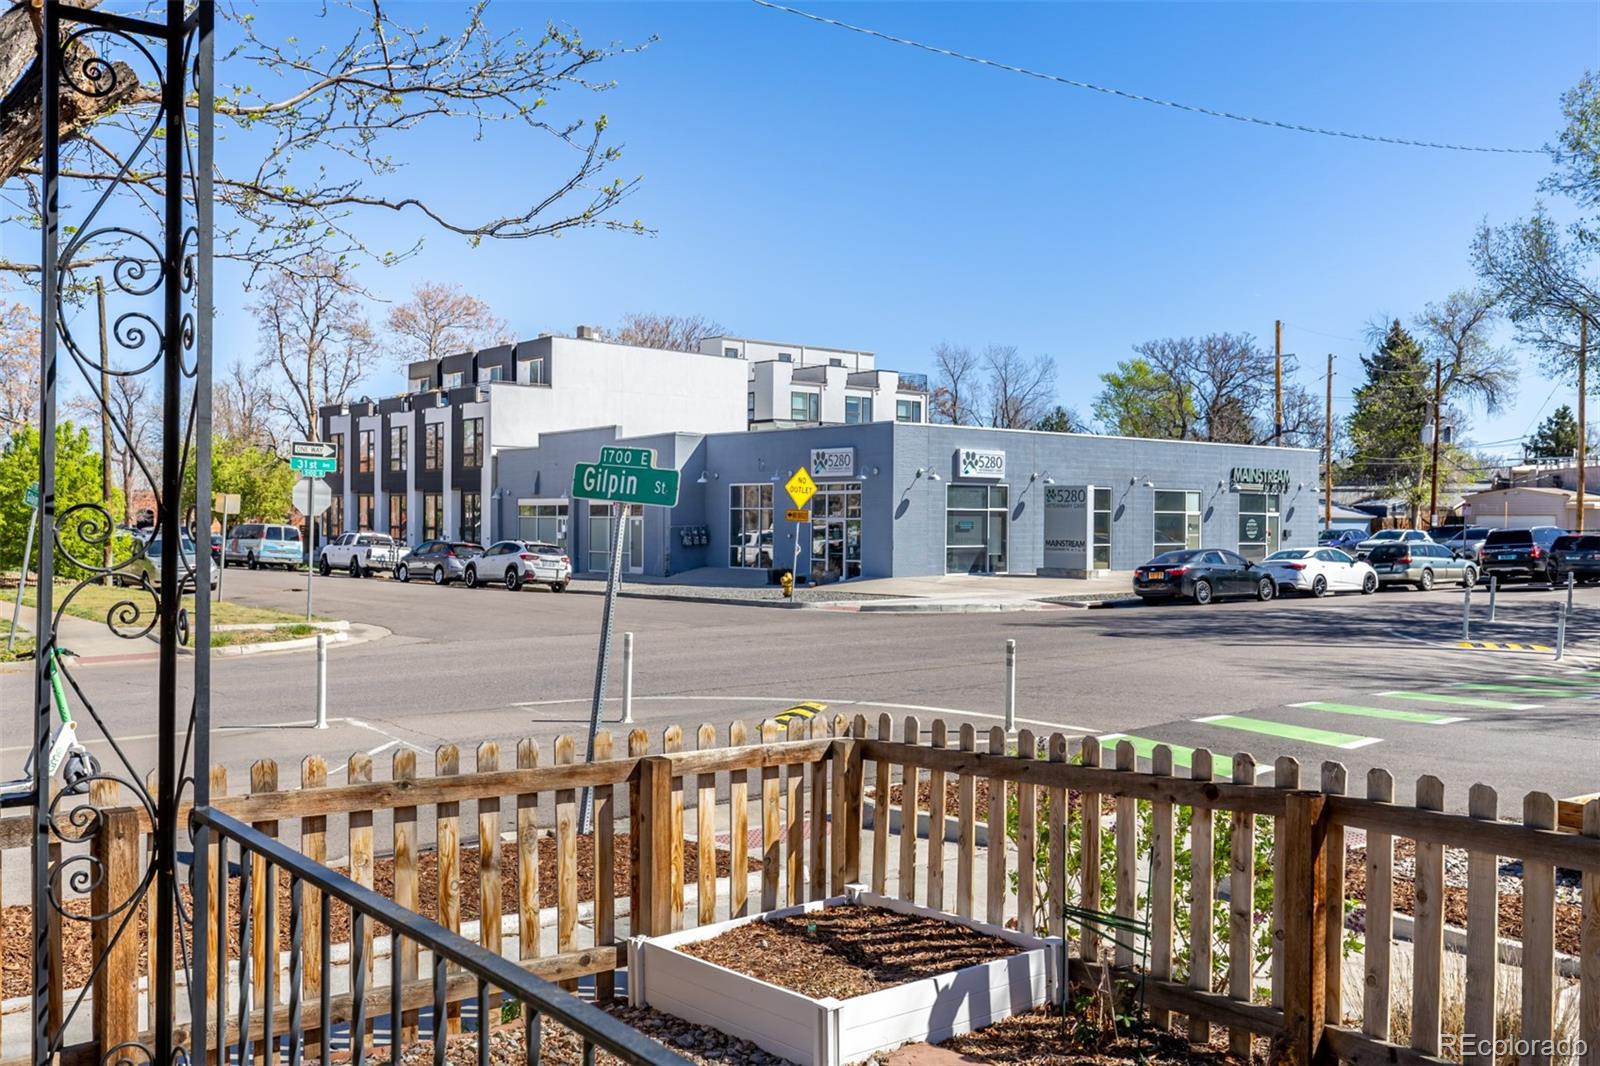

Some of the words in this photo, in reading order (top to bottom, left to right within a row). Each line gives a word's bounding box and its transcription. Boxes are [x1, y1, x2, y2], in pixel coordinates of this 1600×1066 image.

[297, 460, 317, 469] 31st
[603, 449, 632, 464] 1700
[641, 452, 649, 466] E
[828, 453, 851, 467] 5280
[978, 455, 1003, 469] 5280
[583, 466, 638, 499] Gilpin
[1231, 467, 1291, 484] MAINSTREAM
[790, 486, 813, 494] OUTLET
[1057, 489, 1086, 503] 5280
[1045, 539, 1086, 548] MAINSTREAM
